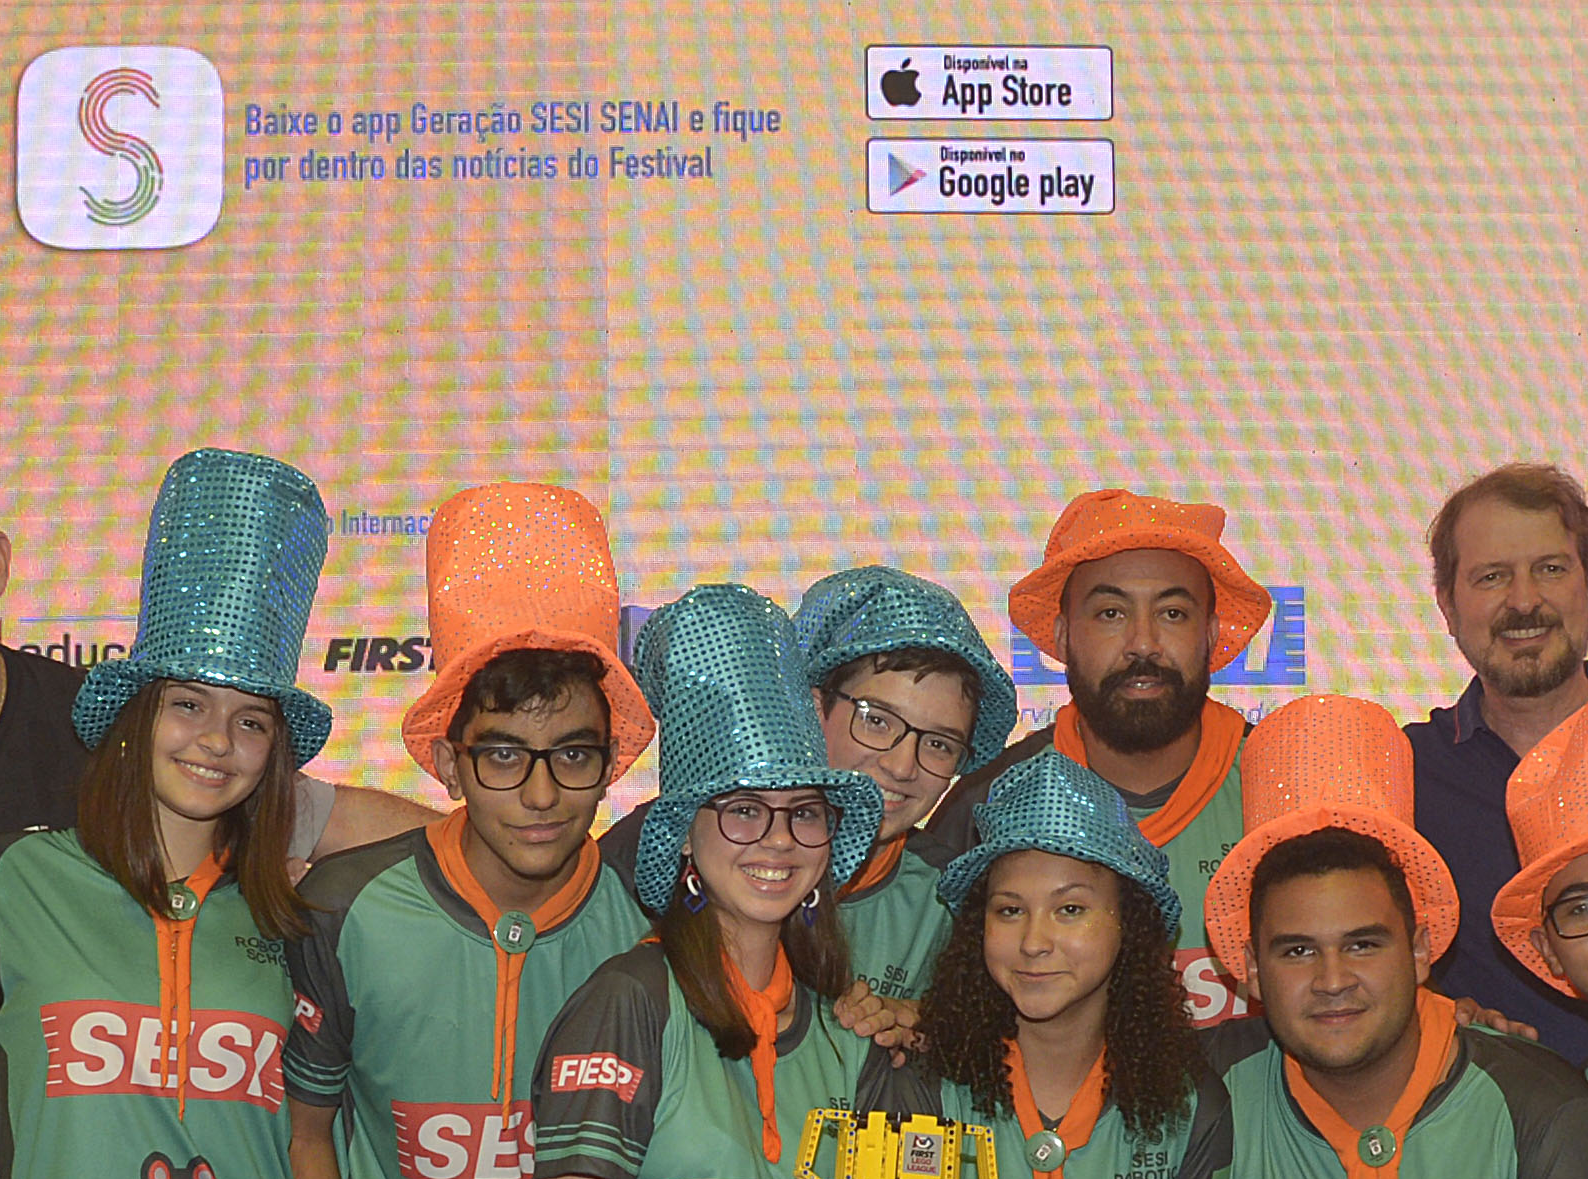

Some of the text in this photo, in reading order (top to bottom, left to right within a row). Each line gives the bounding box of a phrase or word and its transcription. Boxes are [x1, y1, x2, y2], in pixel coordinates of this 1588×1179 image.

[1013, 58, 1028, 70] na
[942, 74, 1072, 114] App Store
[245, 100, 780, 143] Baixe o app Geração SESI SENAI e fique
[245, 146, 713, 189] por dentro das notícias do Festival
[1009, 150, 1026, 162] no
[939, 165, 1095, 206] Google play
[66, 1011, 278, 1098] SESI
[558, 1057, 633, 1089] FIESP
[1132, 1150, 1169, 1168] SESI
